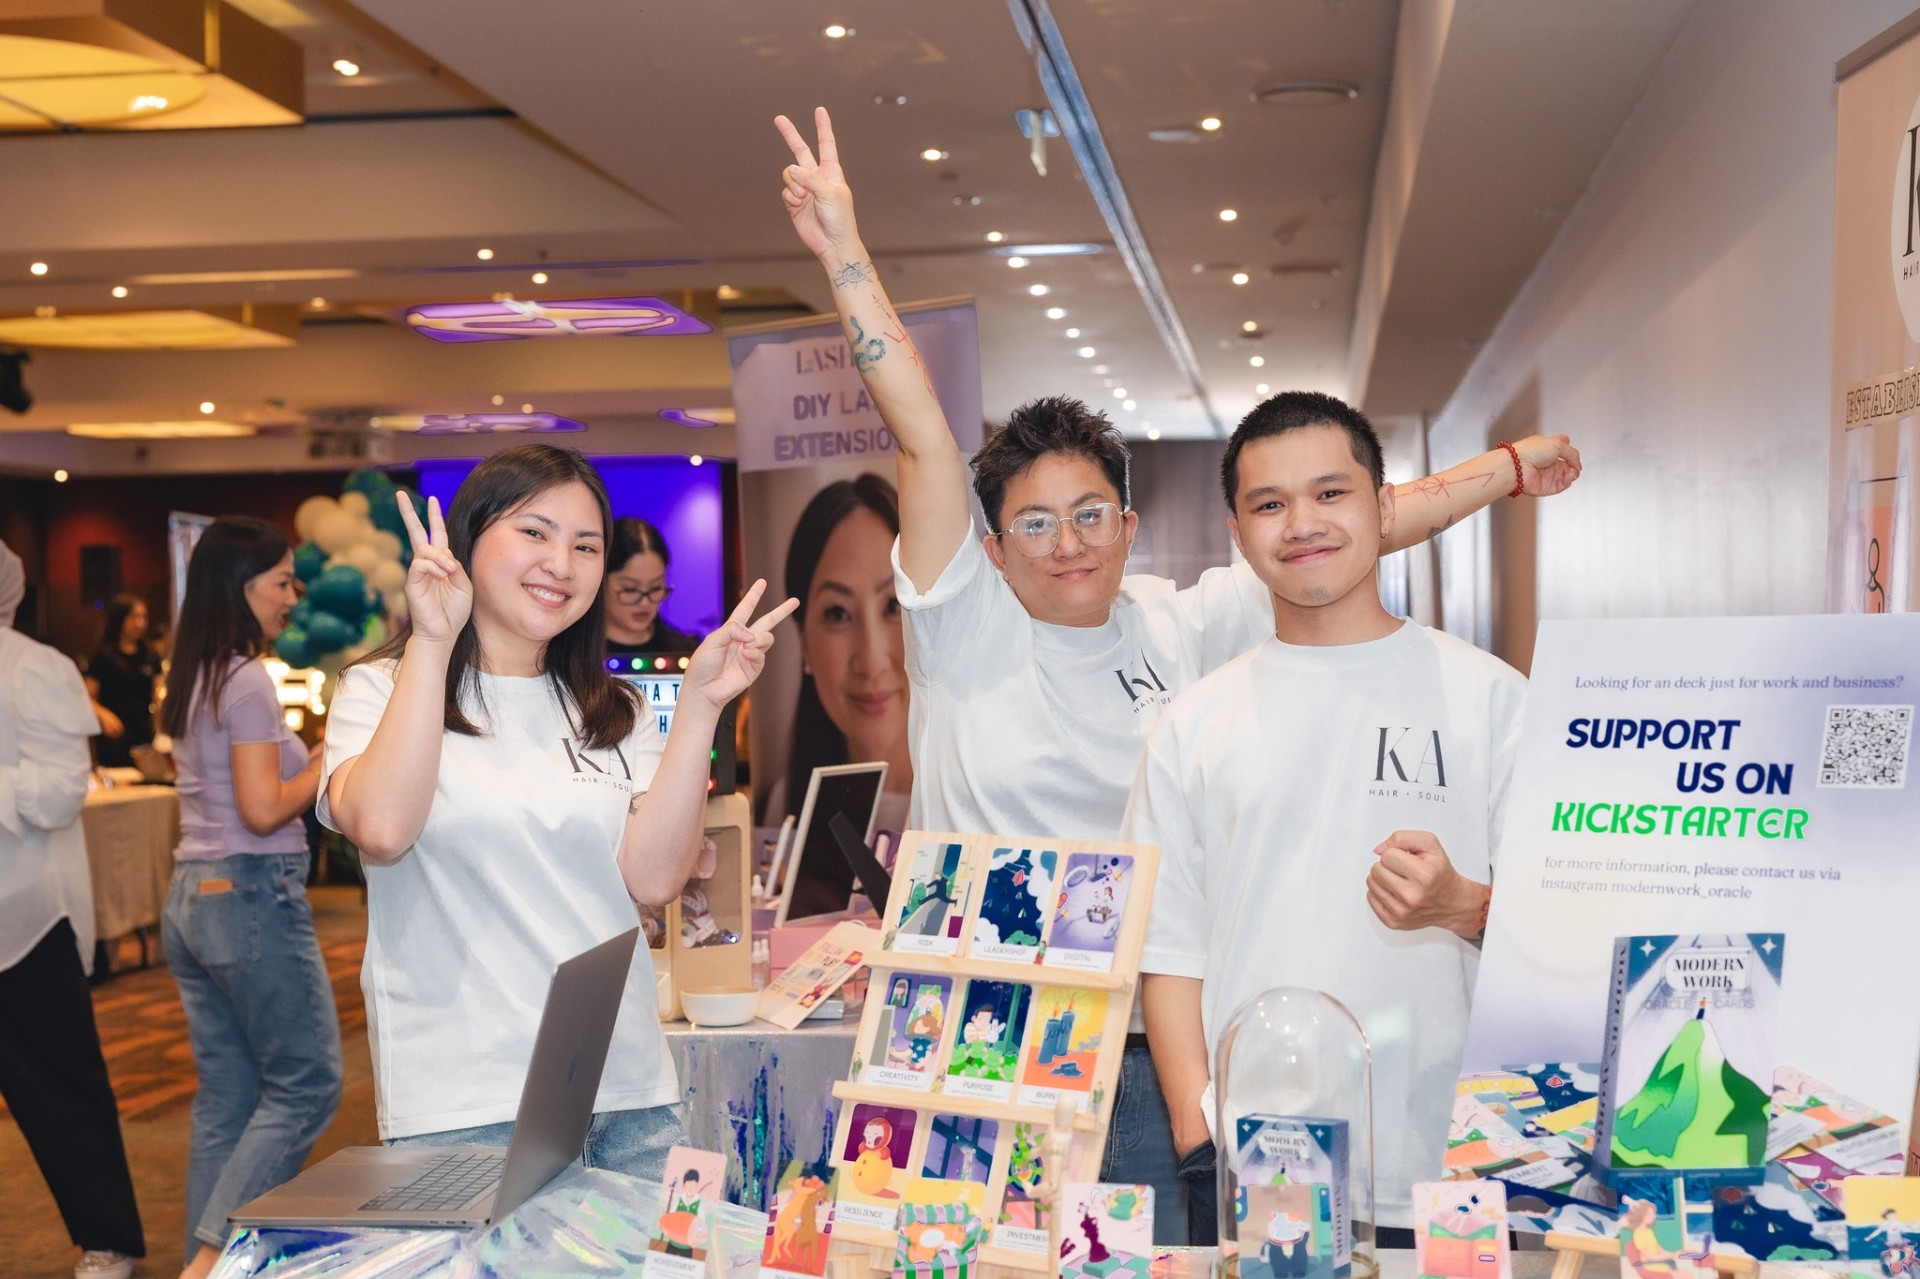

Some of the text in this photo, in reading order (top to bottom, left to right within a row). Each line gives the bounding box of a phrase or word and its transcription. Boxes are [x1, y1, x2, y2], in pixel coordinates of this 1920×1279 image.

[793, 389, 877, 420] DIY LA
[774, 427, 898, 462] EXTENSIO
[1575, 675, 1904, 691] Looking for an deck just for work and business?
[1565, 718, 1741, 750] SUPPORT
[1371, 726, 1449, 788] KA
[1676, 761, 1794, 795] US ON
[613, 781, 632, 793] SOU
[1369, 788, 1446, 803] HAIR SOUL
[1551, 802, 1810, 839] KICKSTARTER
[1544, 856, 1842, 881] for more information, please contact us via
[1541, 877, 1752, 899] instagram modernwork_oracle
[917, 938, 934, 947] RISK
[983, 945, 1026, 956] LEADERSHIP
[1674, 957, 1744, 971] MODERN
[1683, 975, 1734, 988] WORK
[879, 1070, 919, 1082] CREATIVITY
[962, 1081, 994, 1093] PURPOSE
[843, 1206, 883, 1220] RESILIENCE
[1006, 1230, 1047, 1242] INVESTMEN
